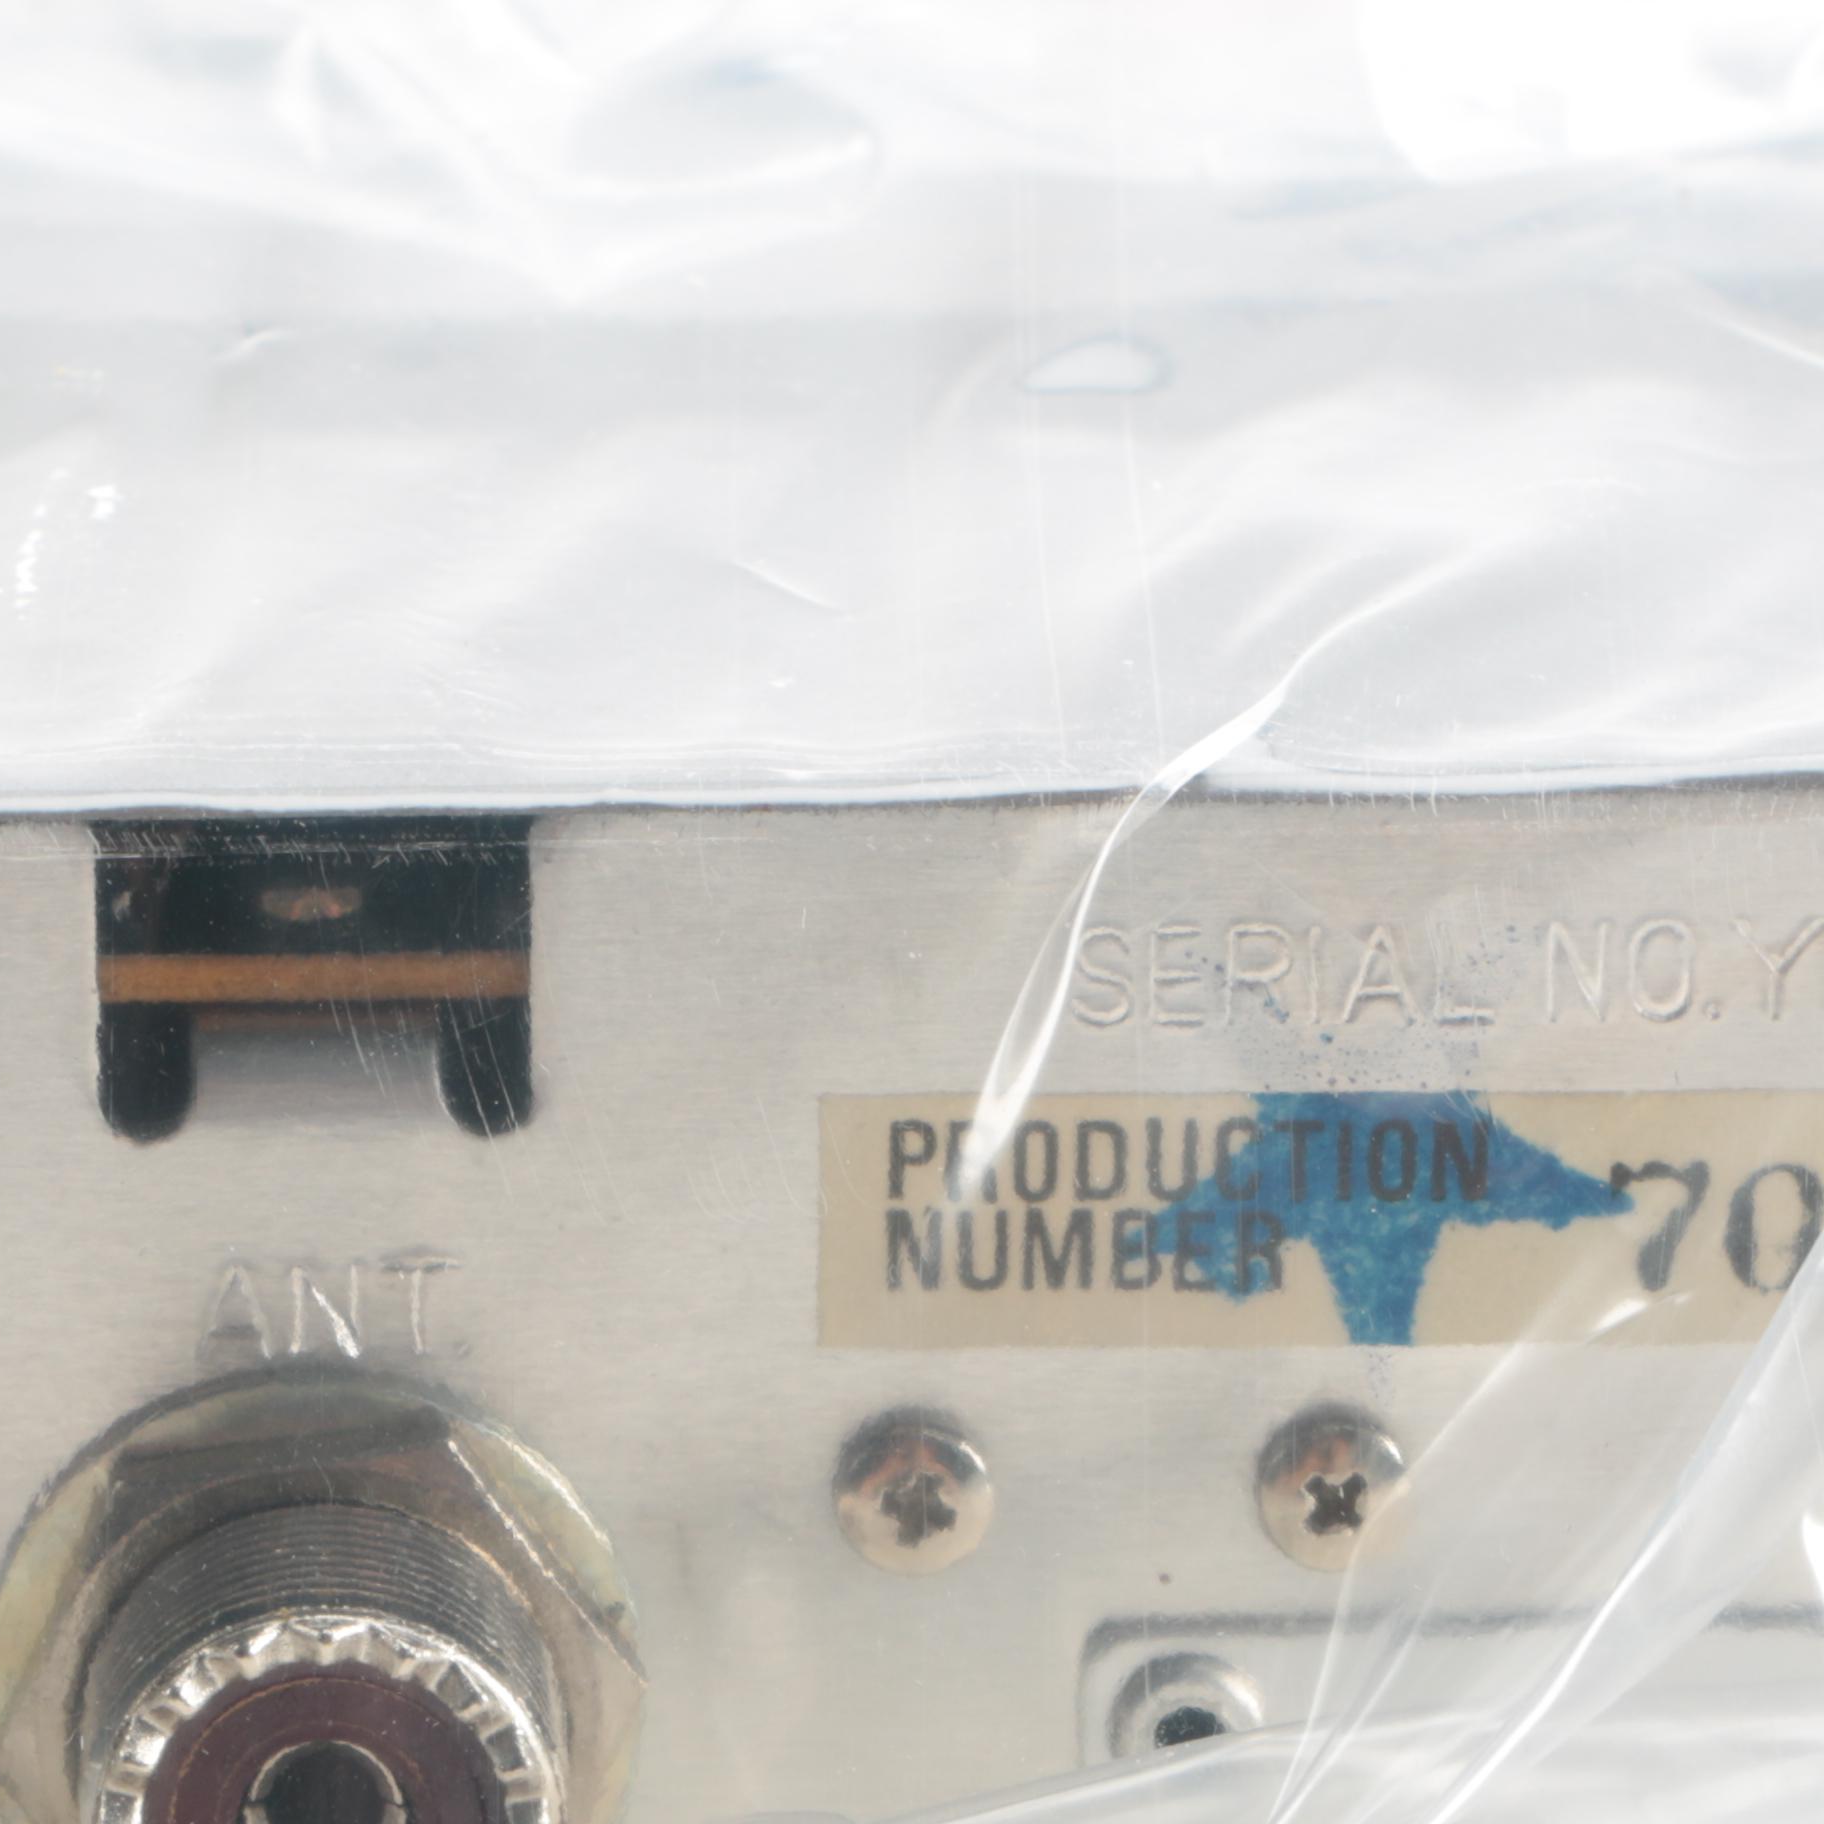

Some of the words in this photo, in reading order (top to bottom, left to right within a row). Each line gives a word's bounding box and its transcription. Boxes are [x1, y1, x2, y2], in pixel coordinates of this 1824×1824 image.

[1071, 918, 1496, 1026] SERIAL
[888, 1117, 1490, 1203] PRODUCTION
[888, 1206, 1286, 1293] NUMBER
[196, 1250, 464, 1358] ANT
